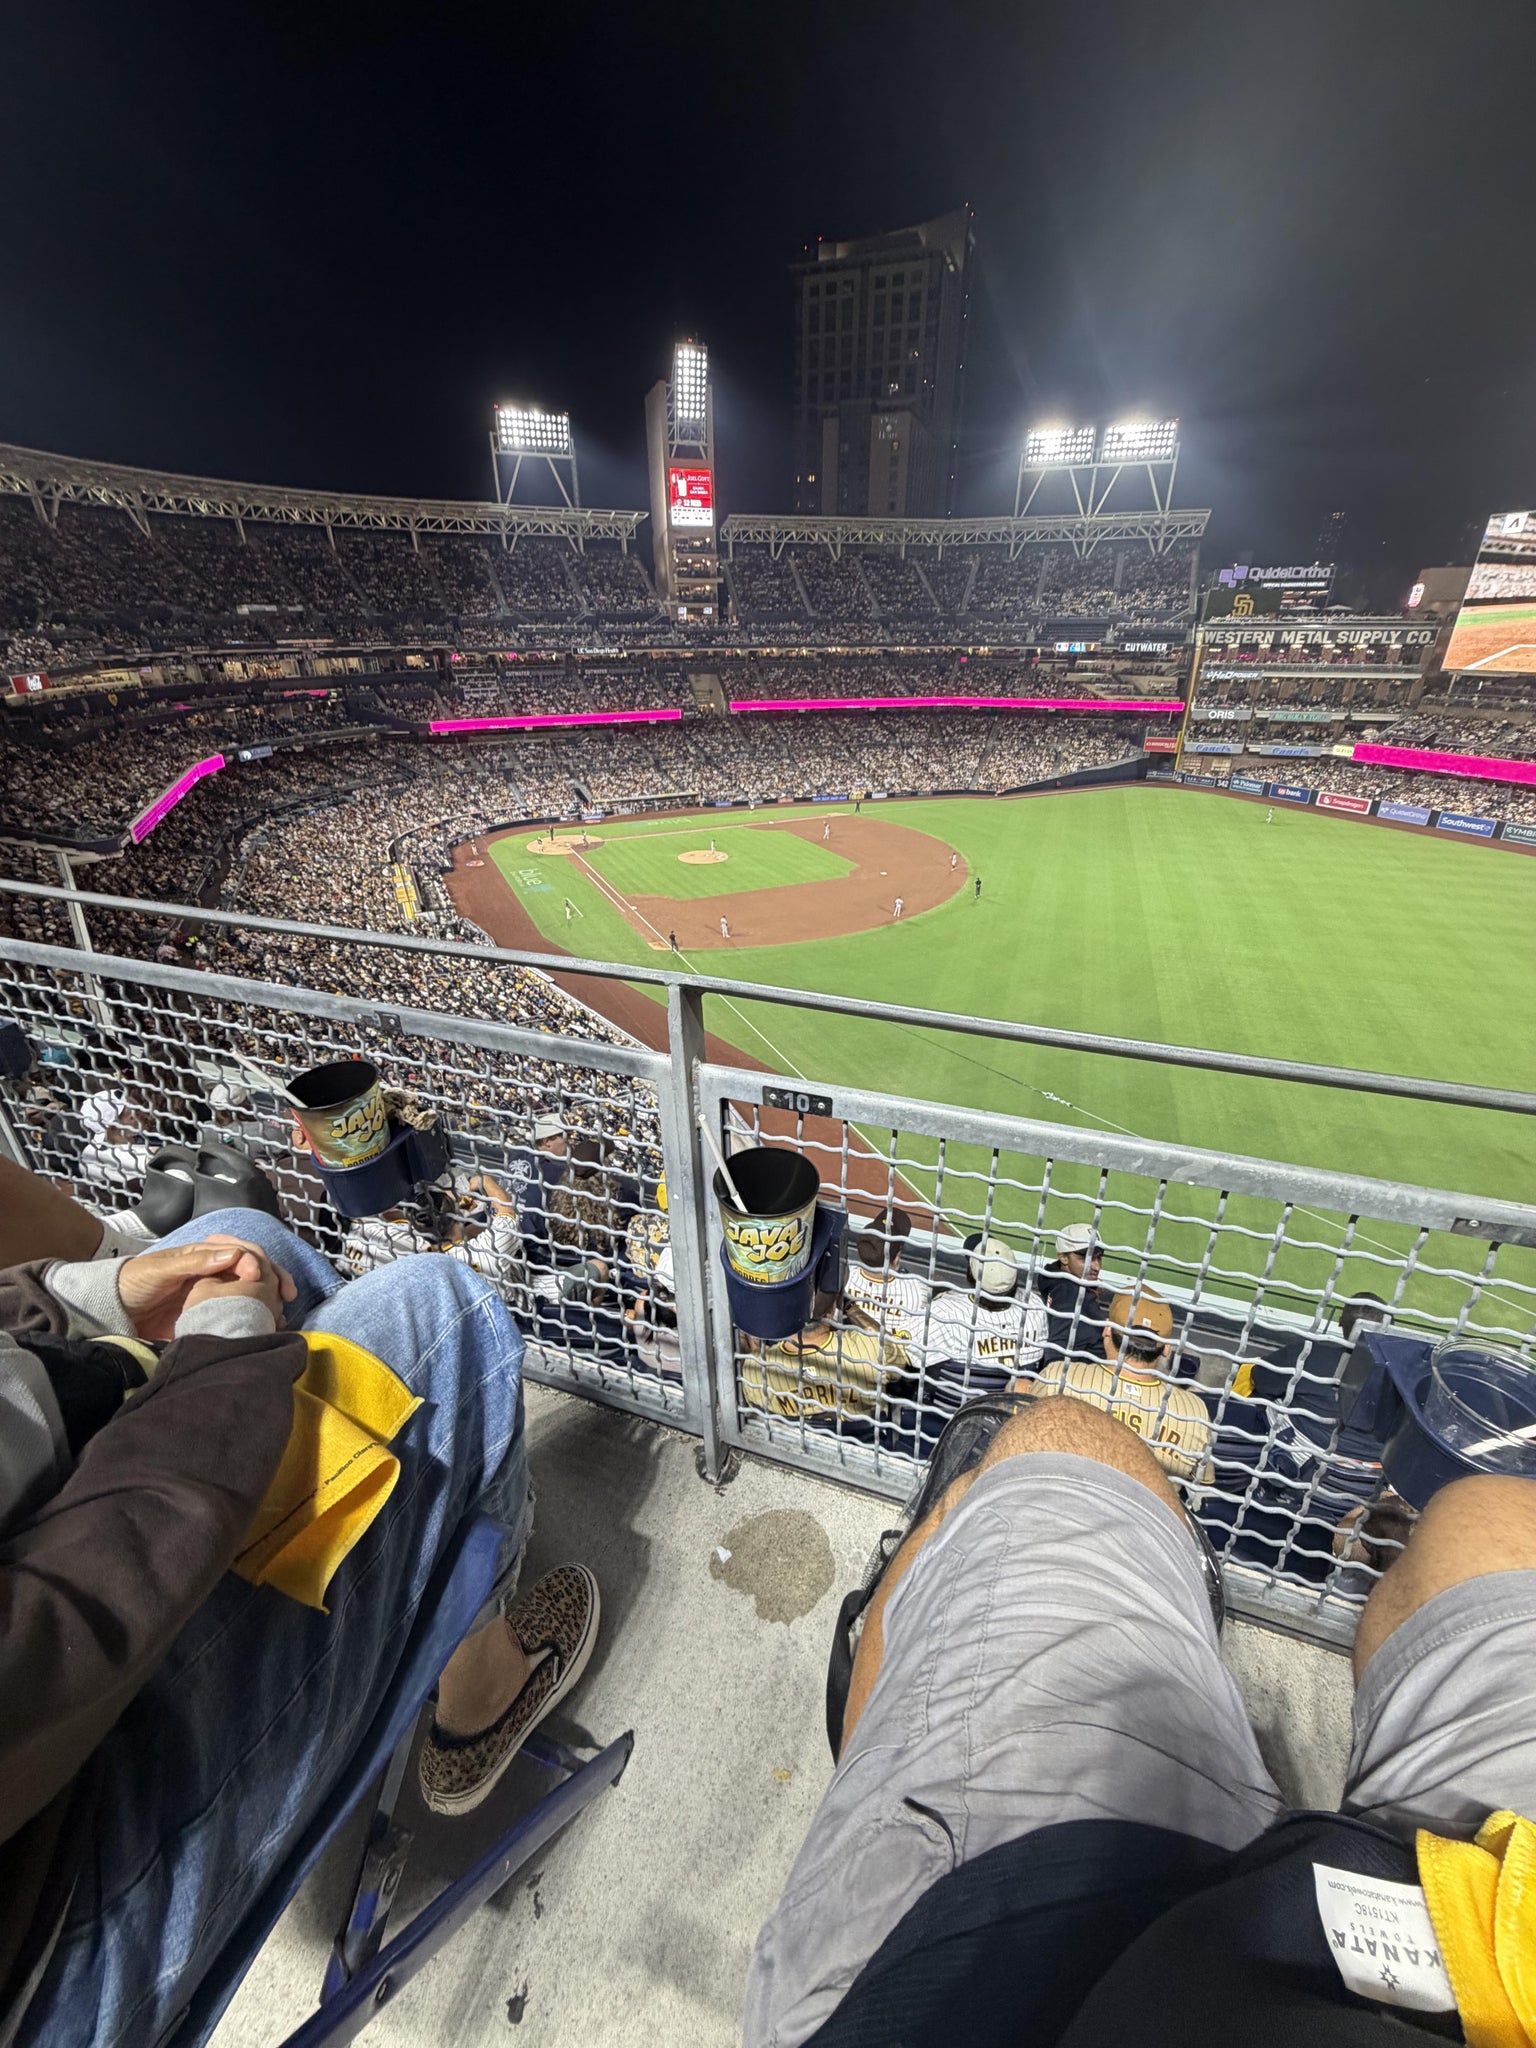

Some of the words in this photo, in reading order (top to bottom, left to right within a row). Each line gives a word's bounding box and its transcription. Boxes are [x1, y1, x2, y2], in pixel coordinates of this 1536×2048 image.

[1249, 566, 1332, 582] QuidelOrtho
[1204, 630, 1275, 644] WESTERN
[1280, 630, 1332, 644] METAL
[1336, 630, 1402, 644] SUPPLY
[1405, 630, 1435, 644] CO.
[1124, 643, 1168, 652] CUTWATER
[1208, 710, 1235, 719] ORIS
[1217, 779, 1229, 788] 342
[1286, 788, 1302, 798] bank
[1332, 798, 1364, 809] Snapdragon
[1441, 817, 1484, 831] Southwest
[783, 1092, 810, 1112] 10
[358, 1109, 384, 1143] JO
[726, 1218, 801, 1246] JAVA
[747, 1225, 808, 1263] JOE
[324, 1459, 354, 1486] Pacifico
[1350, 1921, 1415, 1945] TOWELS
